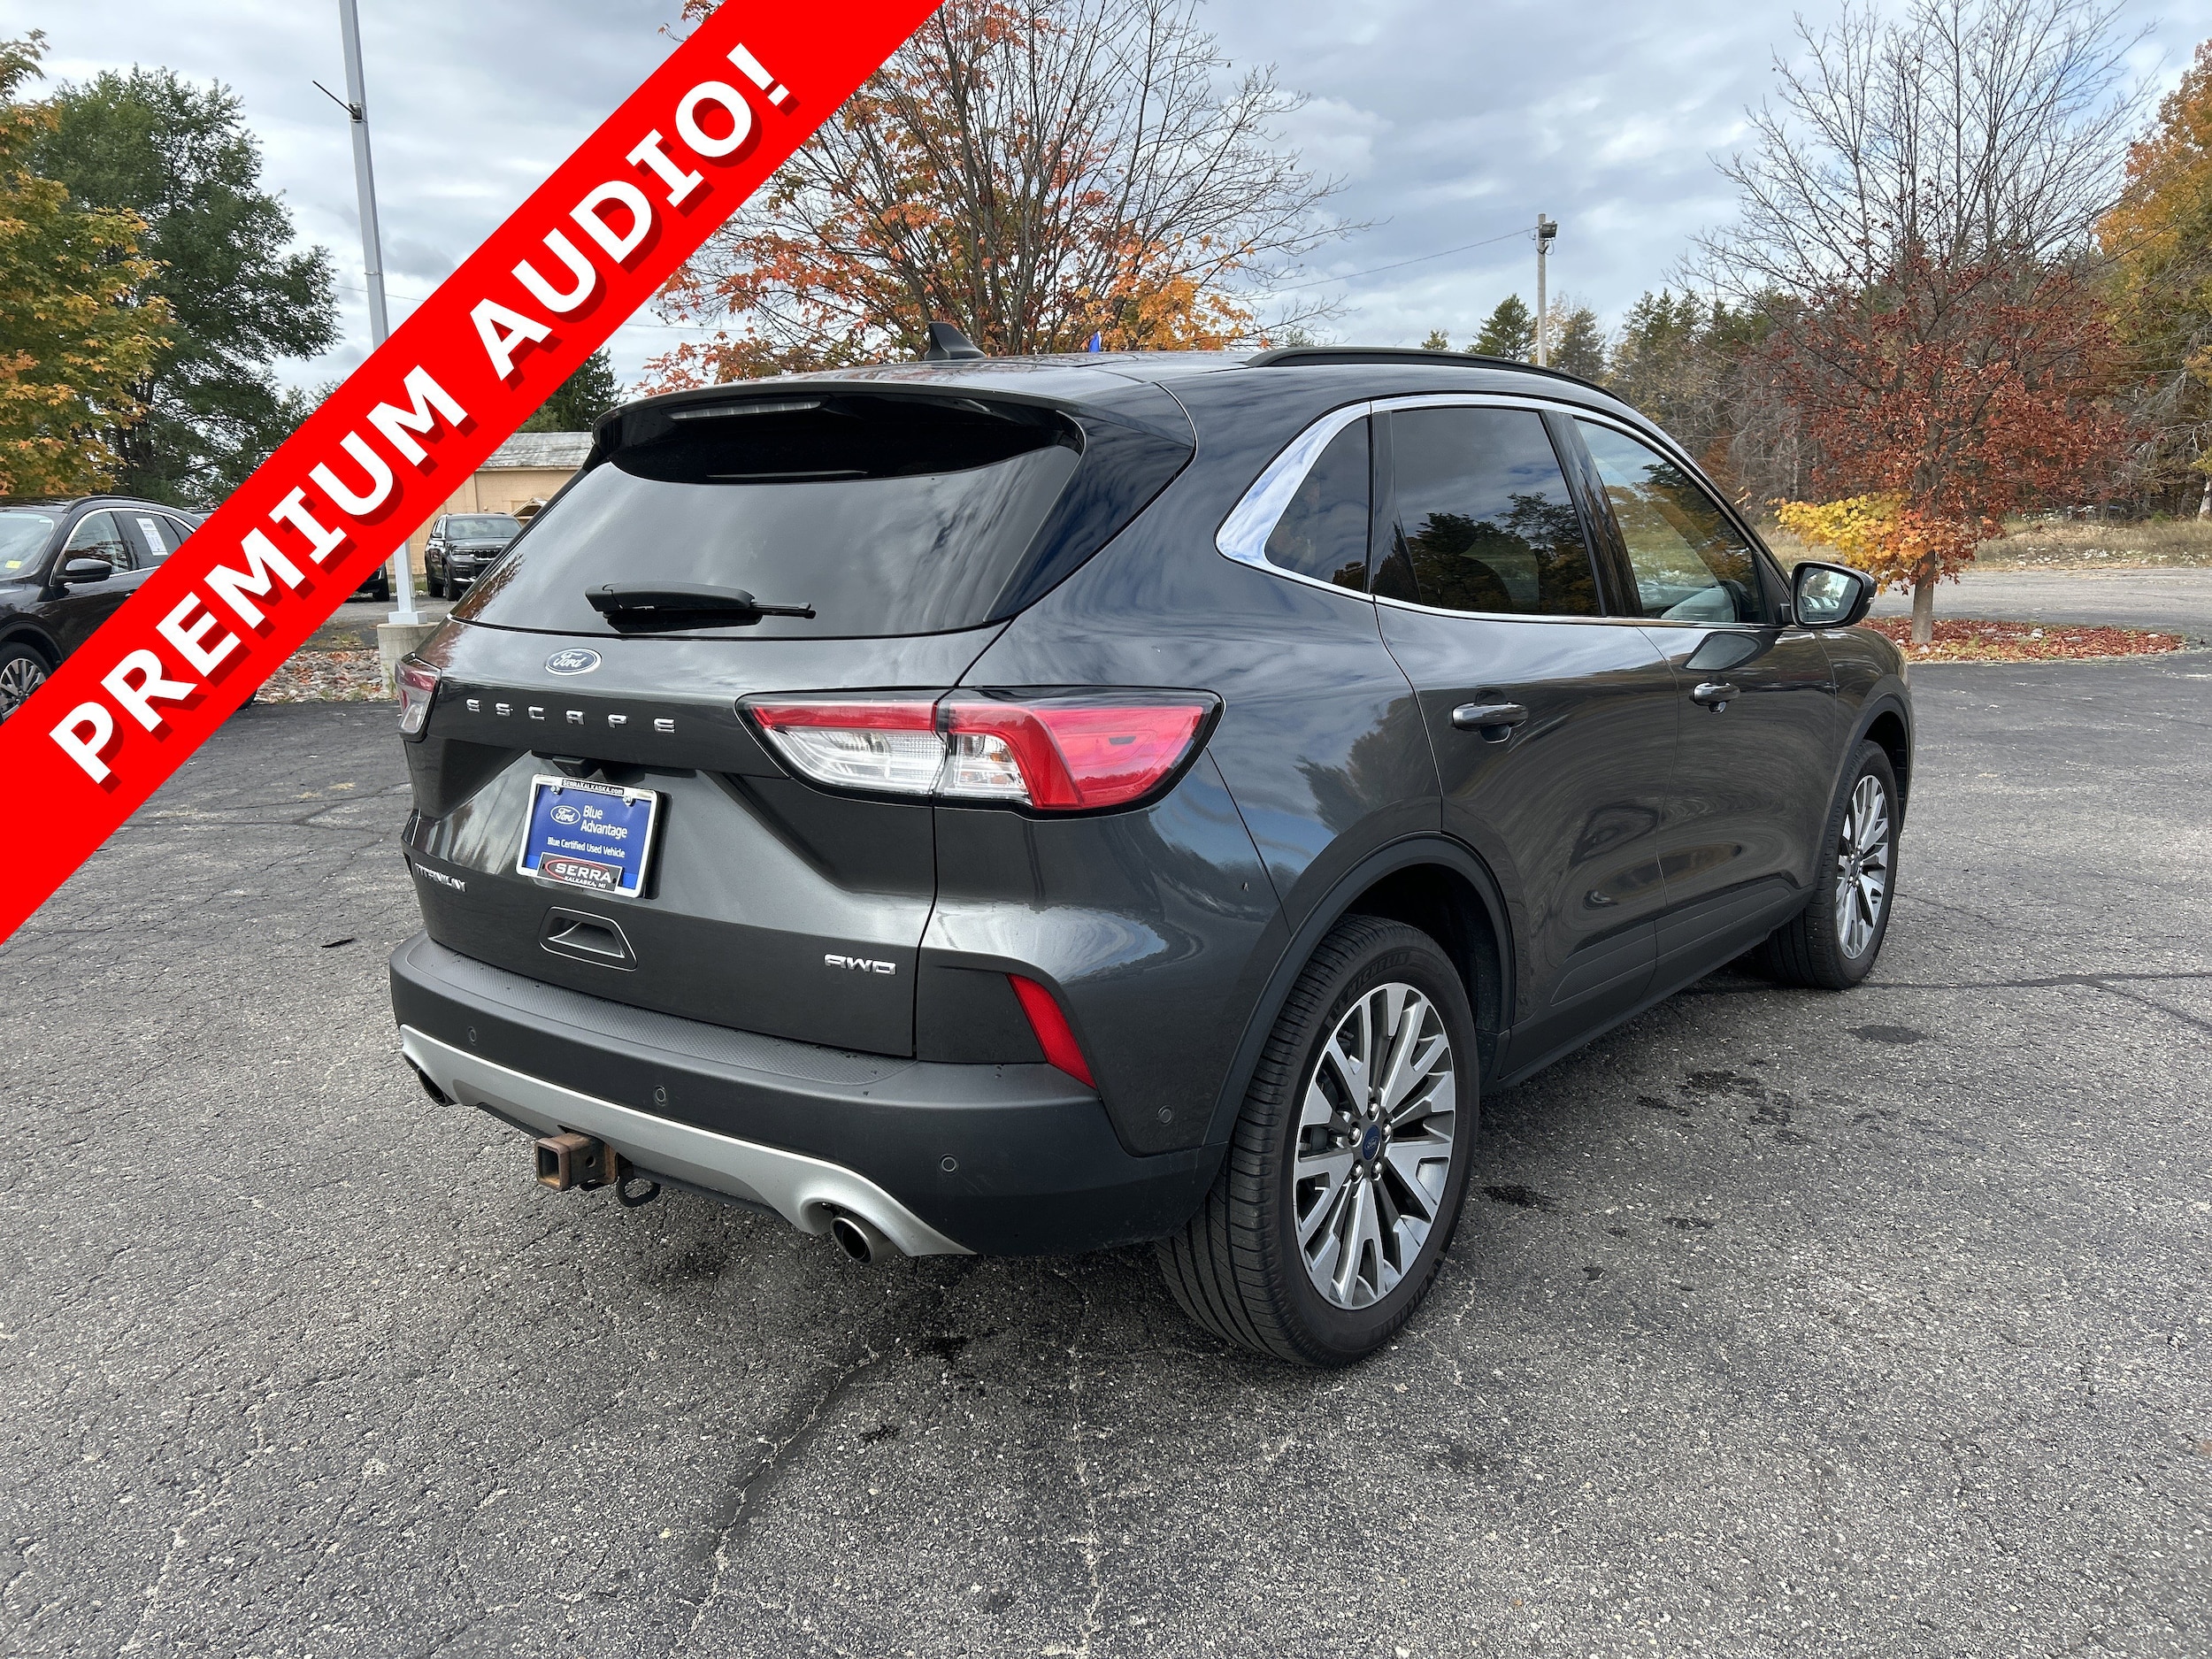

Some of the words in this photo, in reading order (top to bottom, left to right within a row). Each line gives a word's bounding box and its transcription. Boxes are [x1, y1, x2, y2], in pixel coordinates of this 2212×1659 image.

[553, 651, 588, 668] Ford
[465, 698, 675, 733] ESCAPE
[555, 807, 575, 822] Ford
[583, 804, 603, 819] Blue
[580, 819, 628, 840] Advantage
[547, 836, 561, 847] Blue
[561, 838, 586, 851] Certified
[587, 842, 602, 855] Used
[603, 846, 626, 858] Vehicle
[555, 862, 612, 884] SERRA
[824, 954, 896, 975] AWD
